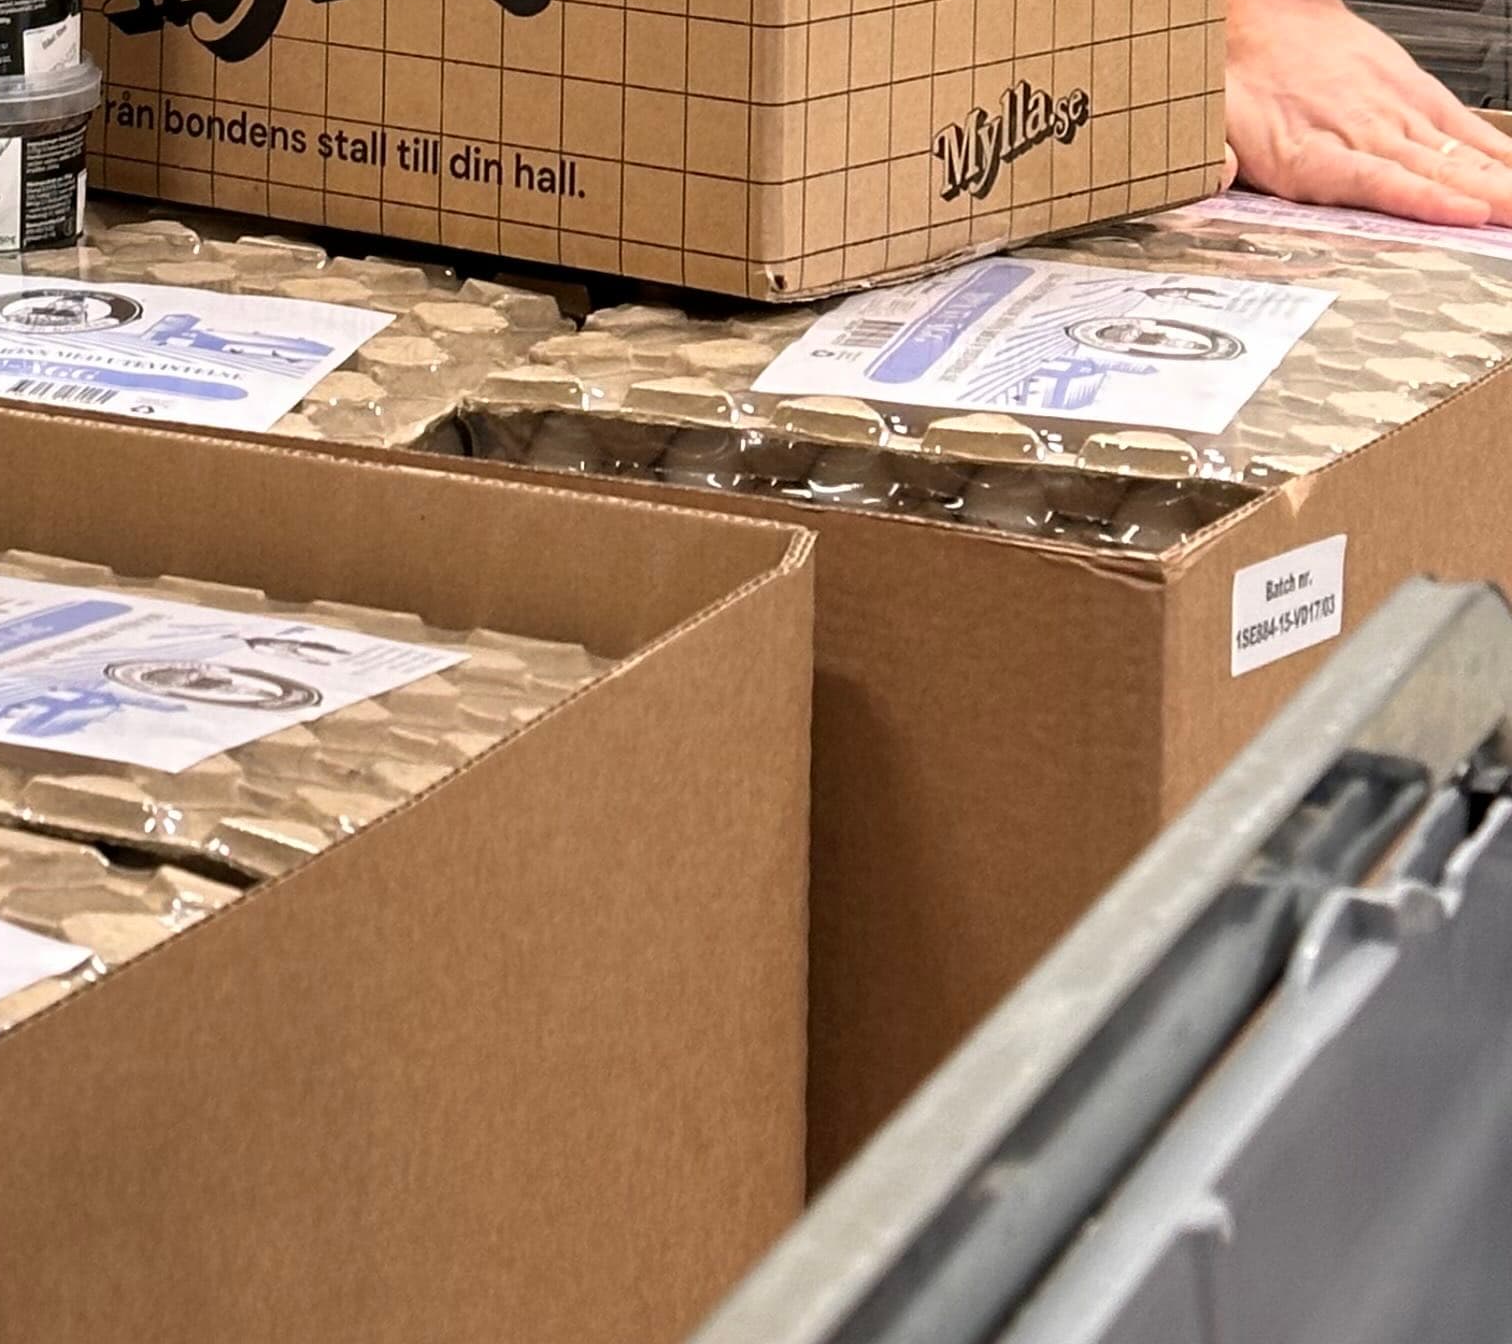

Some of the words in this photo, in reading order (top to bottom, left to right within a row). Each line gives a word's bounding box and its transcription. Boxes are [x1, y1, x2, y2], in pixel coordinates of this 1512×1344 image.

[102, 90, 155, 130] rån
[164, 99, 307, 155] bondens
[317, 129, 387, 168] stall
[396, 137, 440, 176] till
[448, 145, 503, 185] din
[514, 152, 586, 199] hall.
[1265, 573, 1296, 602] Batch
